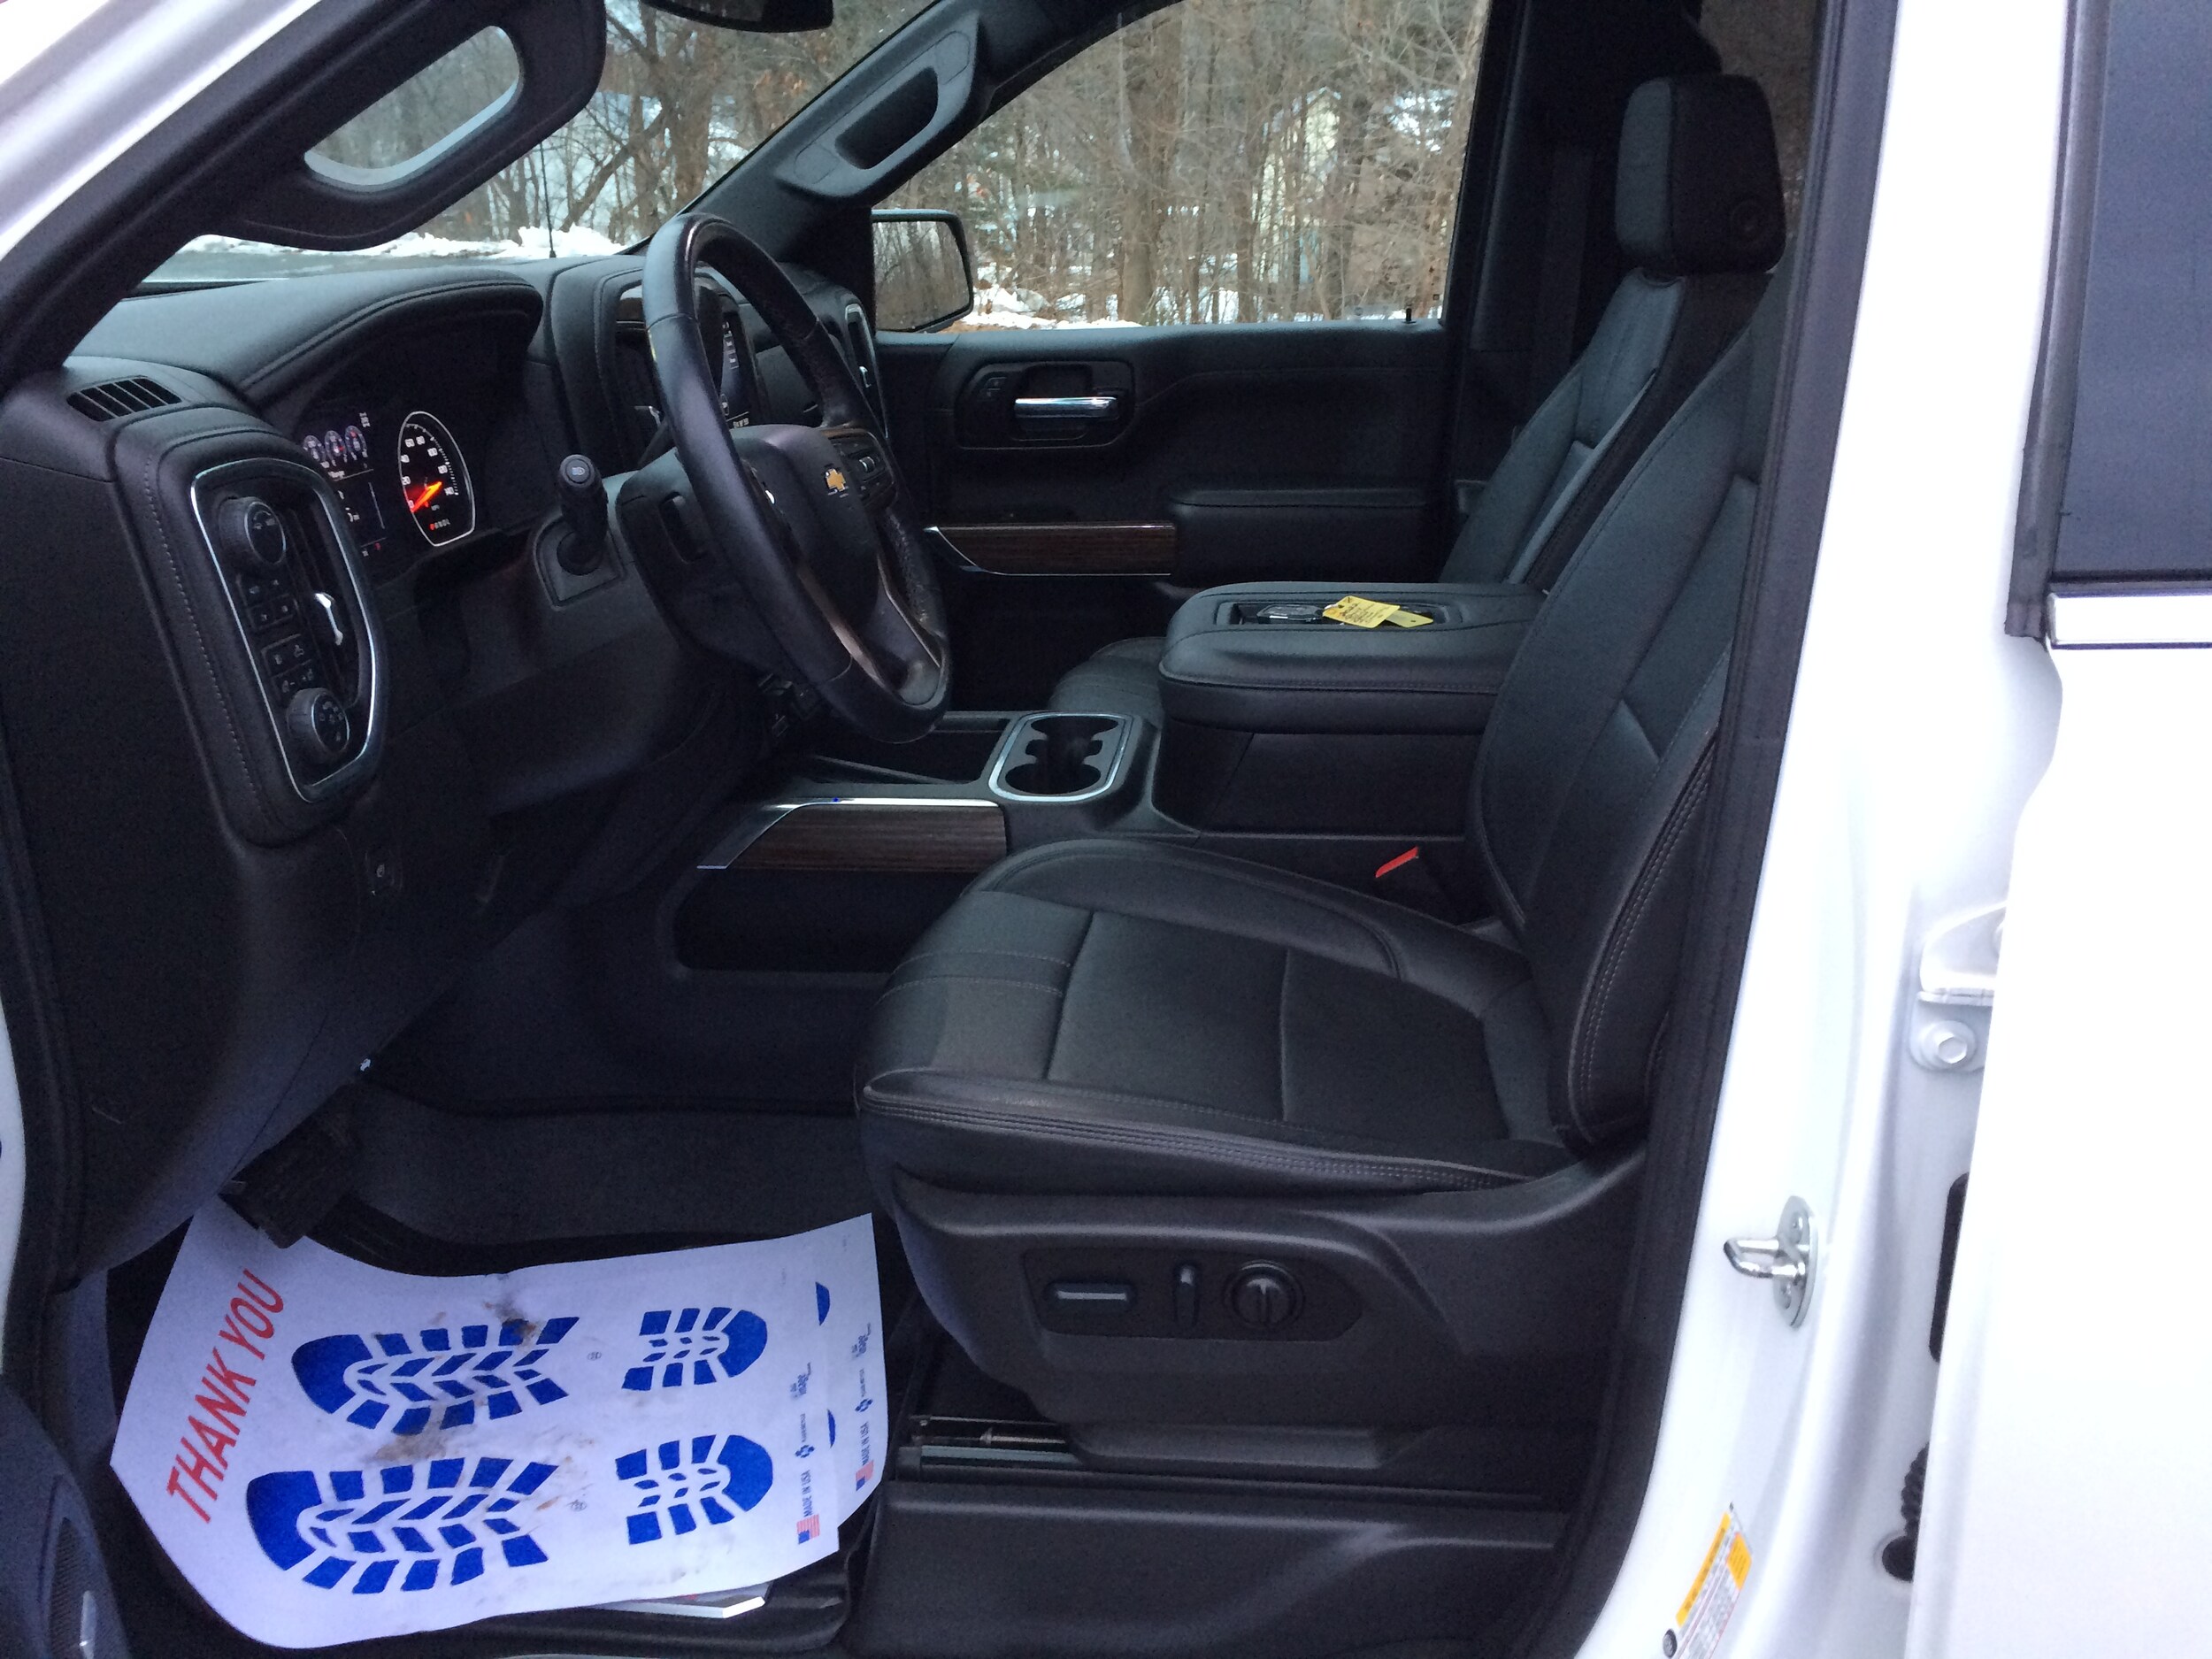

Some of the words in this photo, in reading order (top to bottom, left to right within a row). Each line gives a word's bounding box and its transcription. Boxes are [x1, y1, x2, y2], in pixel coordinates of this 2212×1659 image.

[166, 1346, 257, 1524] THANK
[218, 1267, 284, 1360] YOU
[800, 1469, 811, 1486] USA
